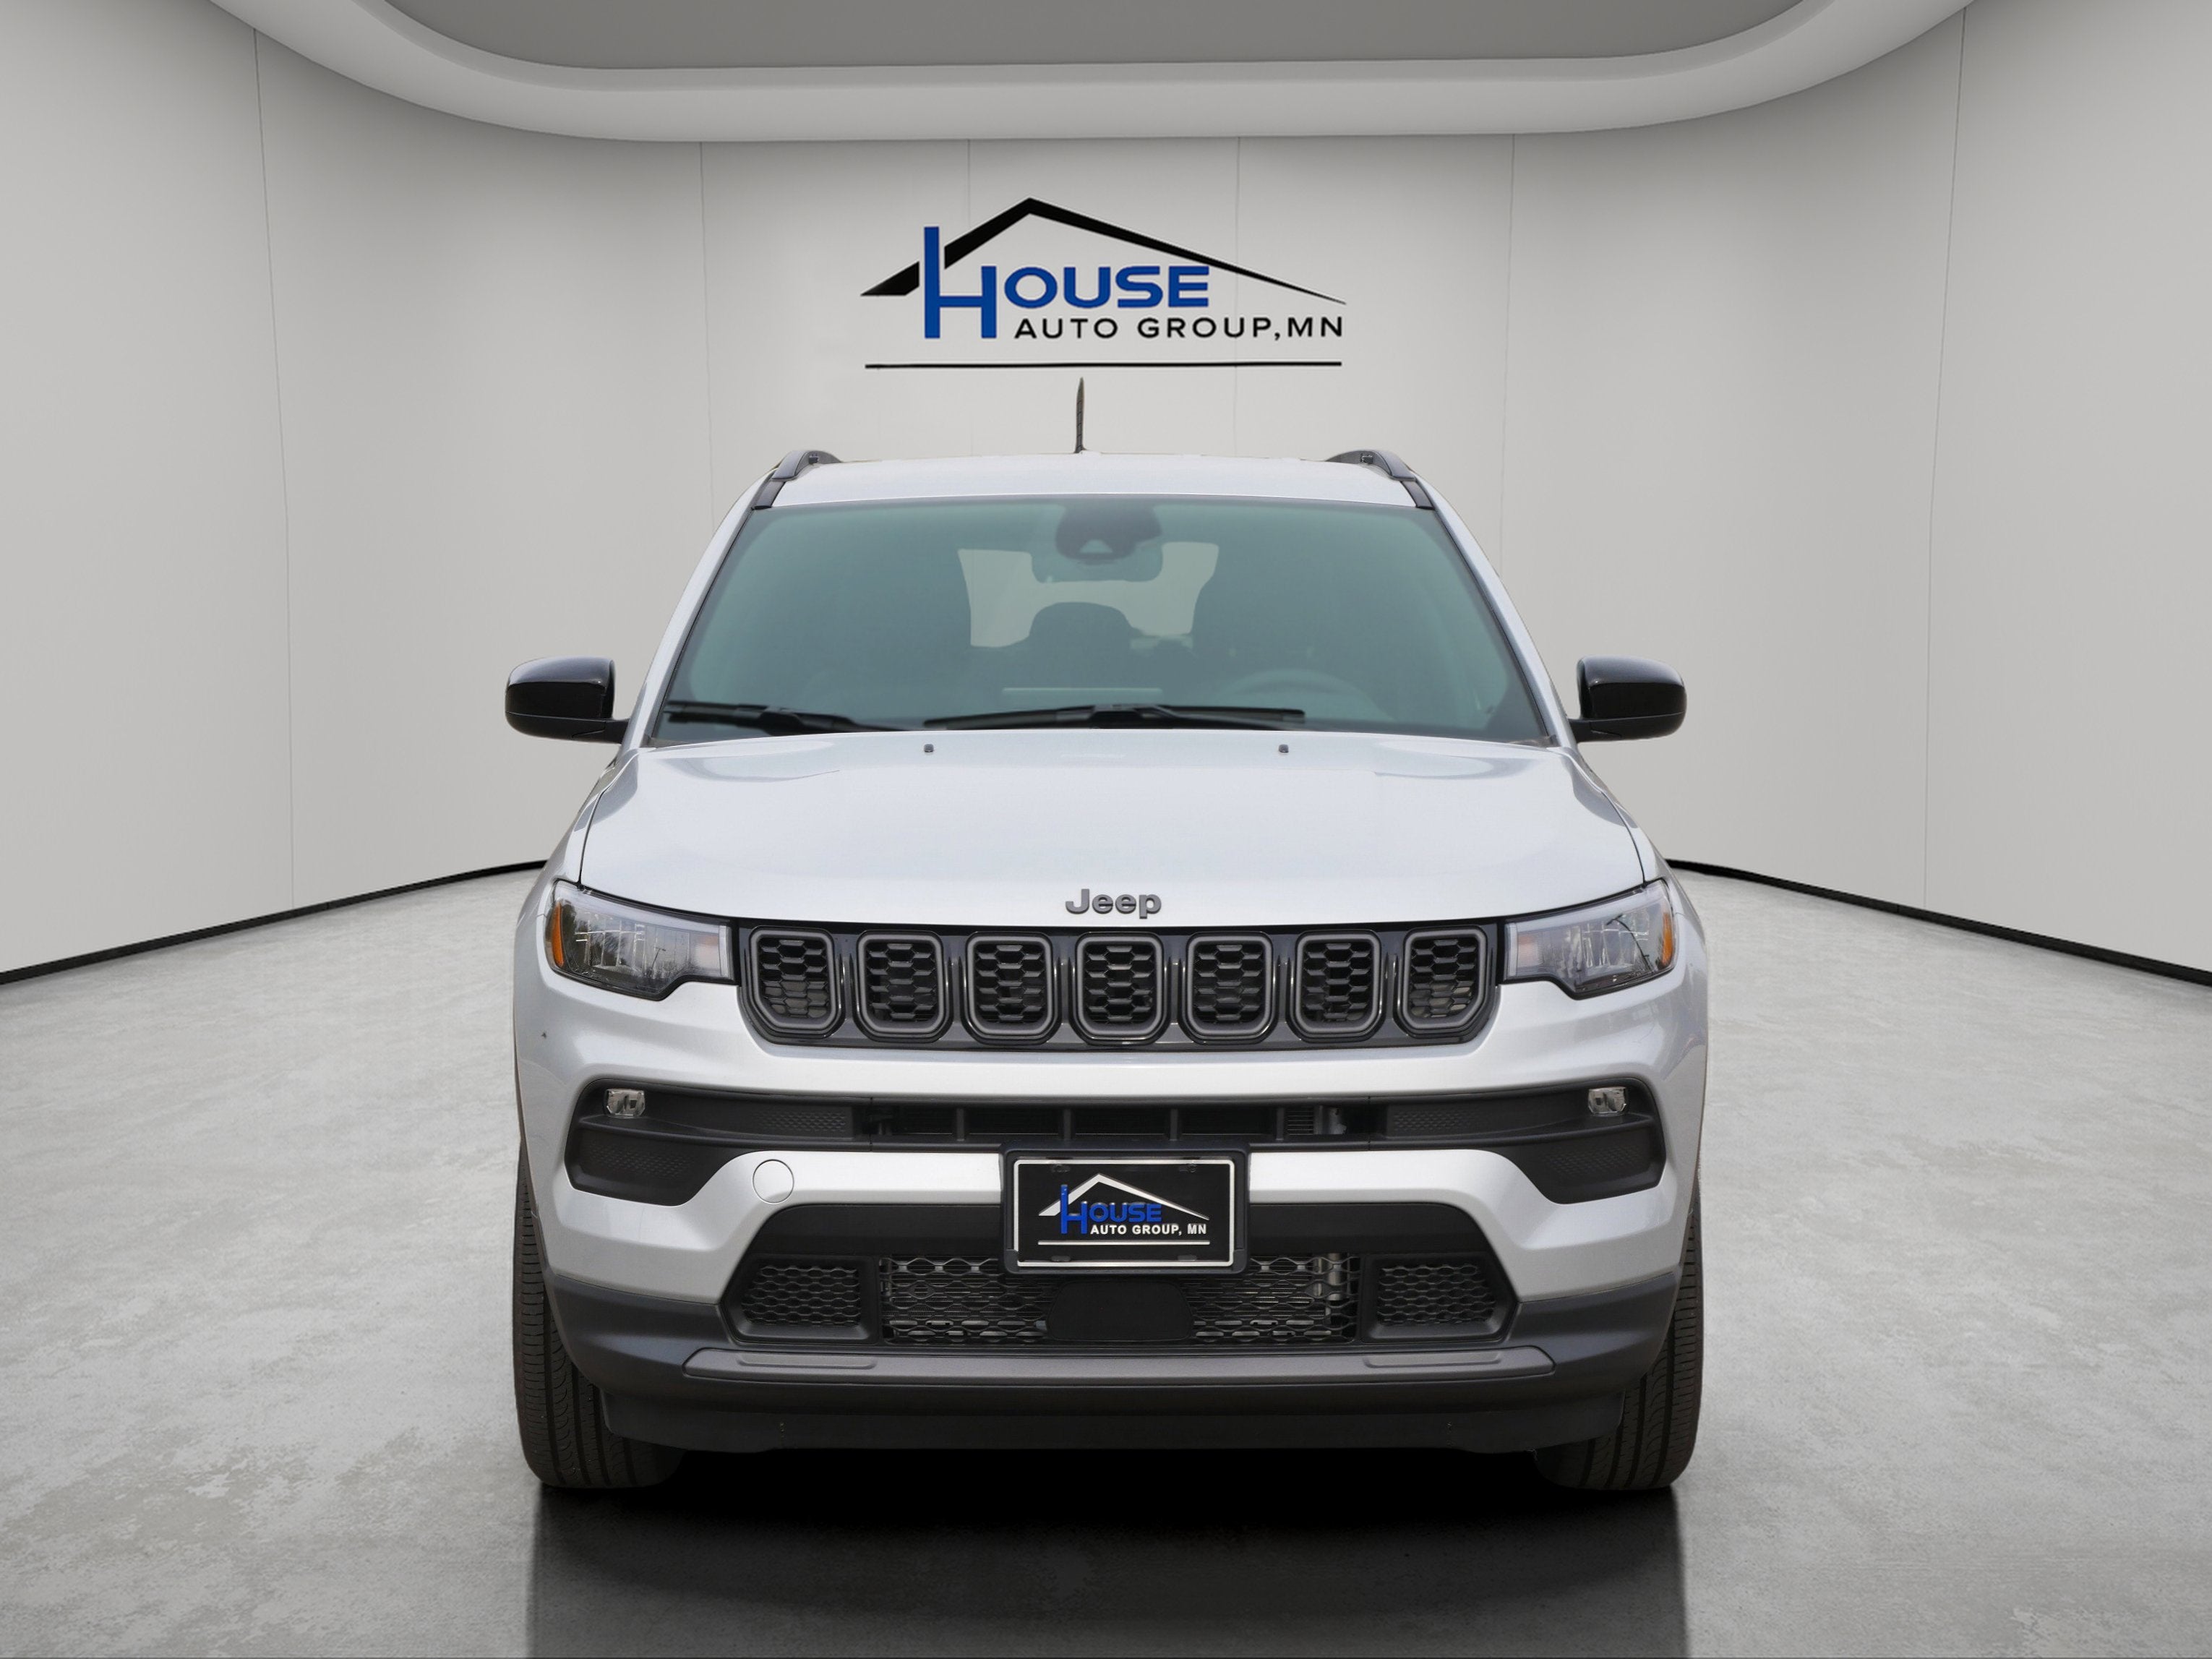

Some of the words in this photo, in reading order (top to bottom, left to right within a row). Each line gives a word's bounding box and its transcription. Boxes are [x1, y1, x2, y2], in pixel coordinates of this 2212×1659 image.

[924, 226, 1209, 339] HOUSE
[1014, 317, 1118, 339] AUTO
[1065, 888, 1162, 919] Jeep
[1060, 1184, 1162, 1234] HOUSE
[1090, 1224, 1127, 1235] AUTO
[1132, 1223, 1182, 1235] GROUP,
[1187, 1223, 1206, 1235] MN
